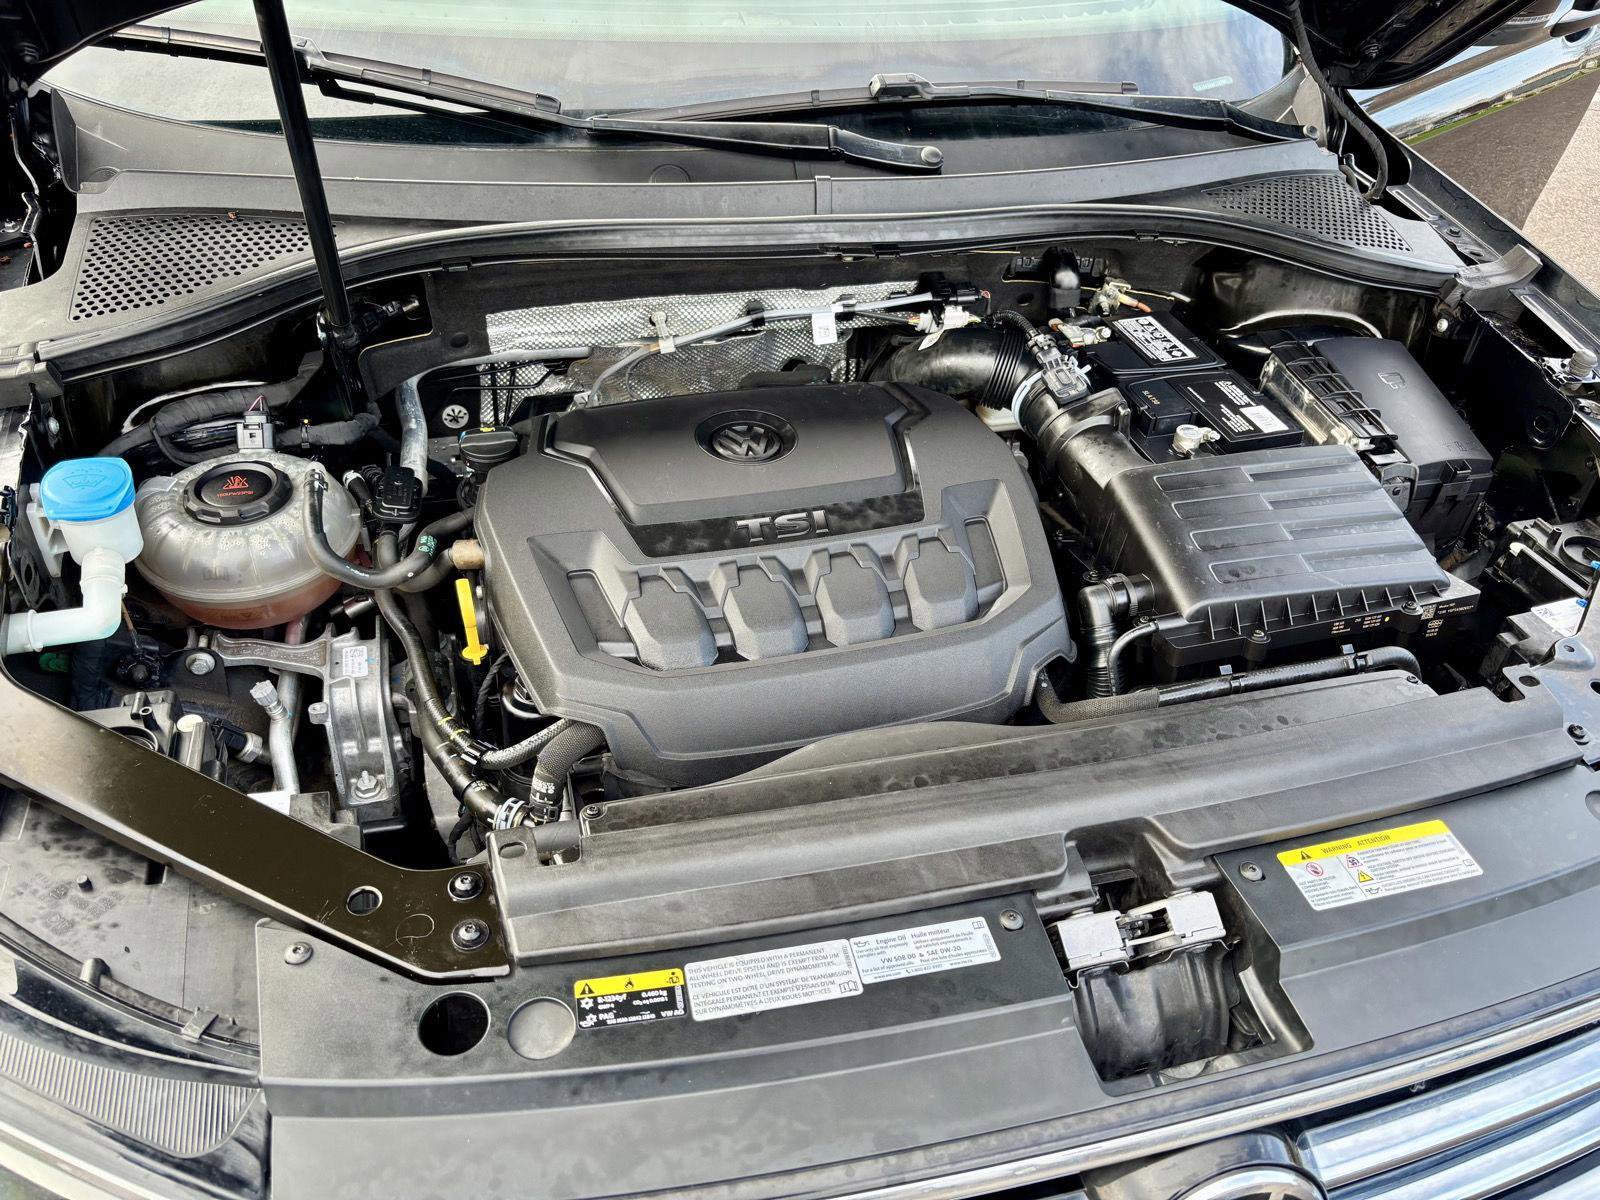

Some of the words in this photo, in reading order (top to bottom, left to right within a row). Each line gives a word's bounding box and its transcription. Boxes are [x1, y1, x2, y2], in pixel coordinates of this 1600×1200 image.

[735, 510, 829, 542] TSI
[1321, 842, 1352, 853] WARNING
[1356, 834, 1391, 846] ATTENTION
[875, 937, 897, 945] Engine
[702, 963, 728, 971] VEHICLE
[735, 957, 765, 966] EQUIPPED
[789, 948, 824, 958] PERMANENT
[688, 971, 722, 980] ALL-WHEEL
[690, 979, 716, 988] TESTING
[727, 972, 766, 982] TWO-WHEEL
[809, 970, 852, 981] TRANSMISSION
[597, 993, 627, 1004] R-1234yf
[726, 992, 760, 1001] PERMANENT
